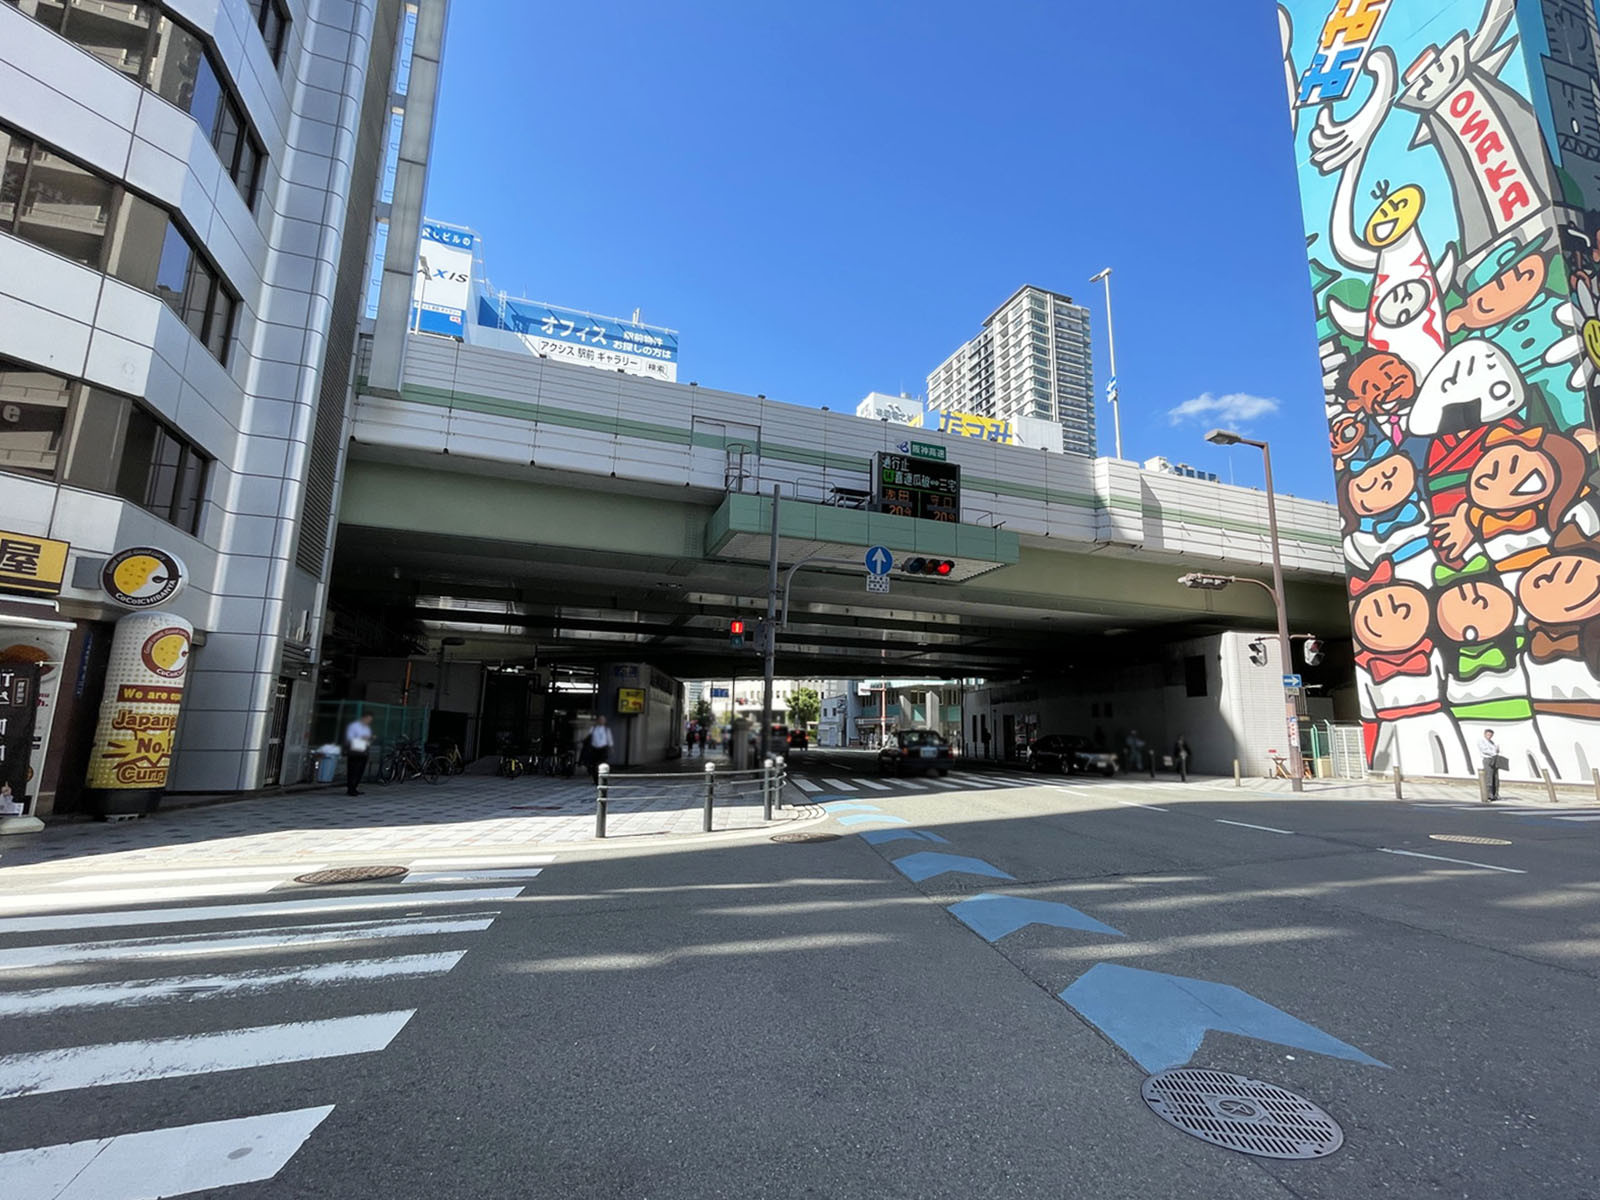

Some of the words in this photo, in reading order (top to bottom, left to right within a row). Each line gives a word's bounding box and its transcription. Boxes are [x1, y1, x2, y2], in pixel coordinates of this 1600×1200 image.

[1449, 90, 1529, 222] OSAKA
[541, 316, 607, 345] オフィス
[540, 341, 575, 357] アクシス
[578, 347, 595, 361] 駅前
[597, 353, 639, 366] ギャラリー
[613, 340, 672, 360] お探しの方は
[940, 410, 1013, 443] たつみ
[882, 455, 910, 472] 通行止
[123, 688, 143, 699] We
[147, 691, 168, 700] are
